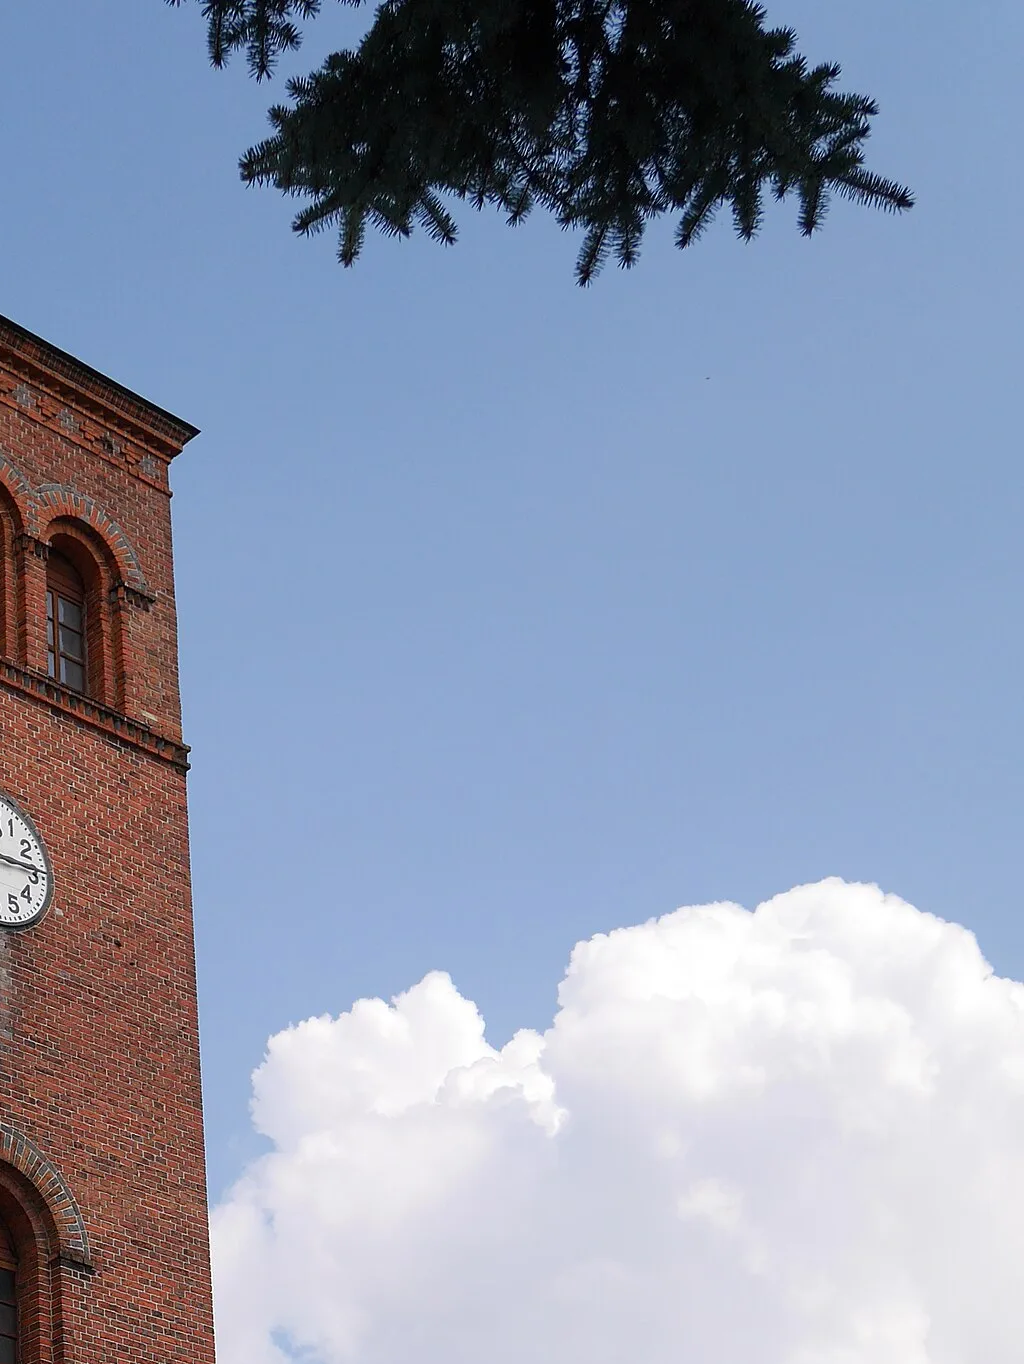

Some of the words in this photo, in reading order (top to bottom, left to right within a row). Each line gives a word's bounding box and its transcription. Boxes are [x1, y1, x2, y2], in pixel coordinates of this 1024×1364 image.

[7, 818, 14, 837] 1
[20, 839, 32, 860] 2
[8, 893, 20, 914] 5
[20, 884, 33, 904] 4
